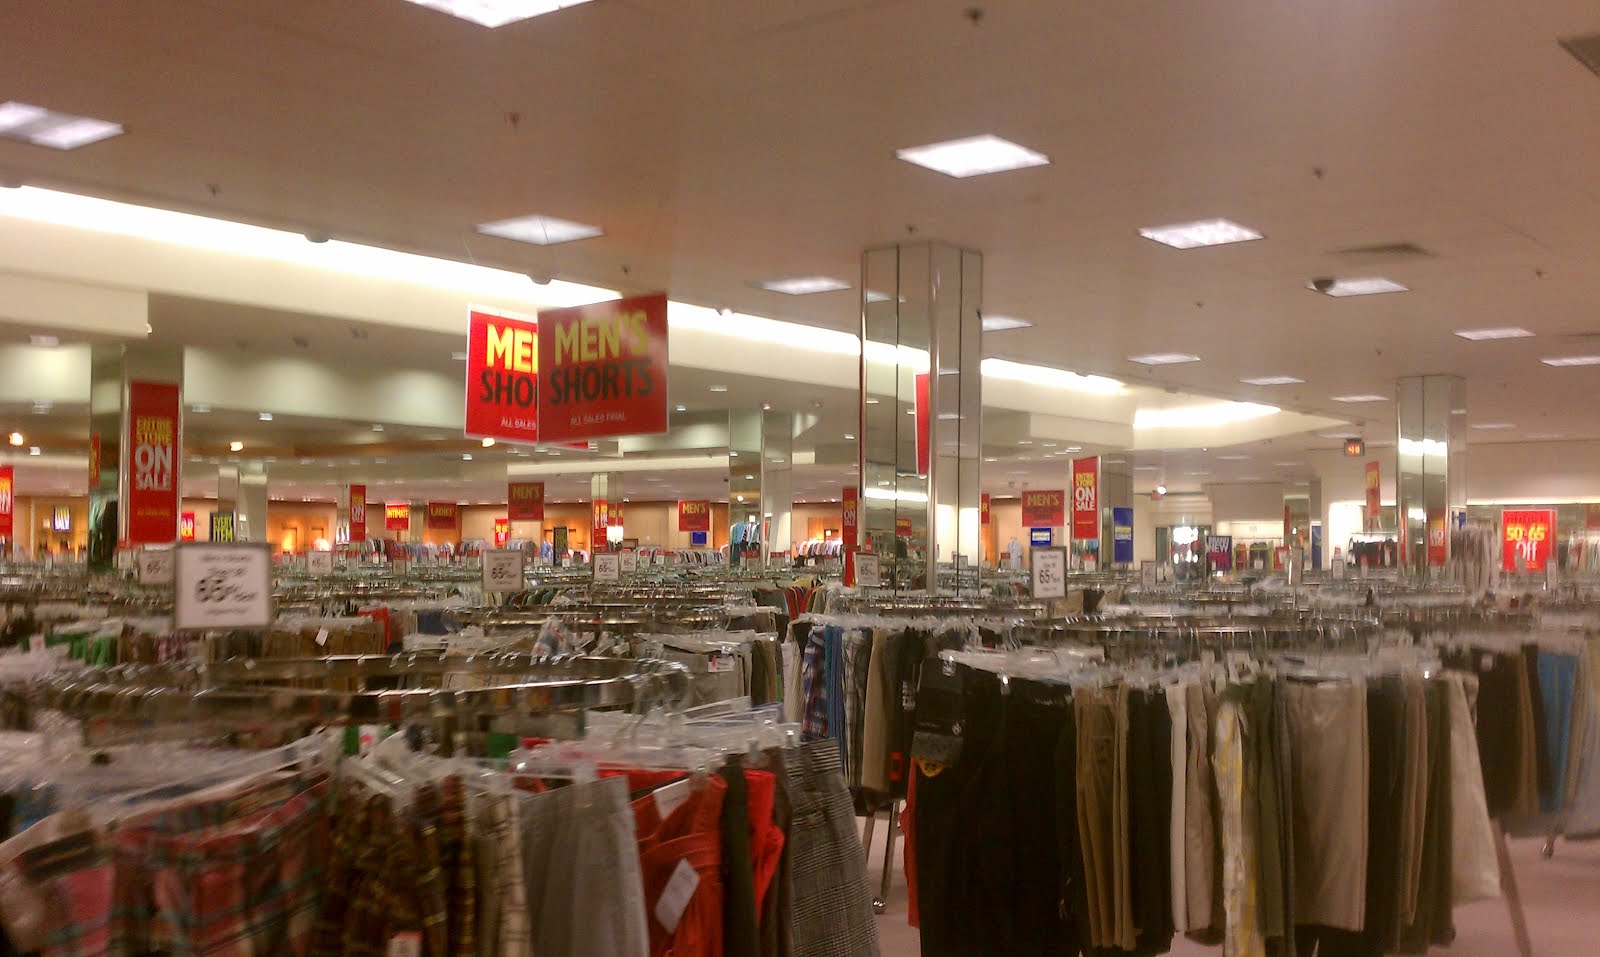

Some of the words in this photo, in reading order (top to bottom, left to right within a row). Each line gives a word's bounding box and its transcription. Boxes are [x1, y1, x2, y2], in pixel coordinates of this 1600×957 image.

[554, 310, 648, 366] MEN'S
[486, 323, 538, 373] ME
[480, 369, 538, 408] SHO
[549, 359, 655, 406] SHORTS
[501, 417, 513, 429] ALL
[514, 421, 537, 430] SALES
[570, 417, 582, 425] ALL
[583, 415, 605, 425] SALES
[135, 443, 172, 473] ON
[136, 472, 171, 491] SALE
[513, 487, 539, 498] MEN'S
[1076, 487, 1094, 501] ON
[1028, 494, 1059, 506] MEN'S
[1076, 501, 1095, 511] SALE
[683, 503, 705, 514] MEN'S
[844, 510, 855, 519] ON
